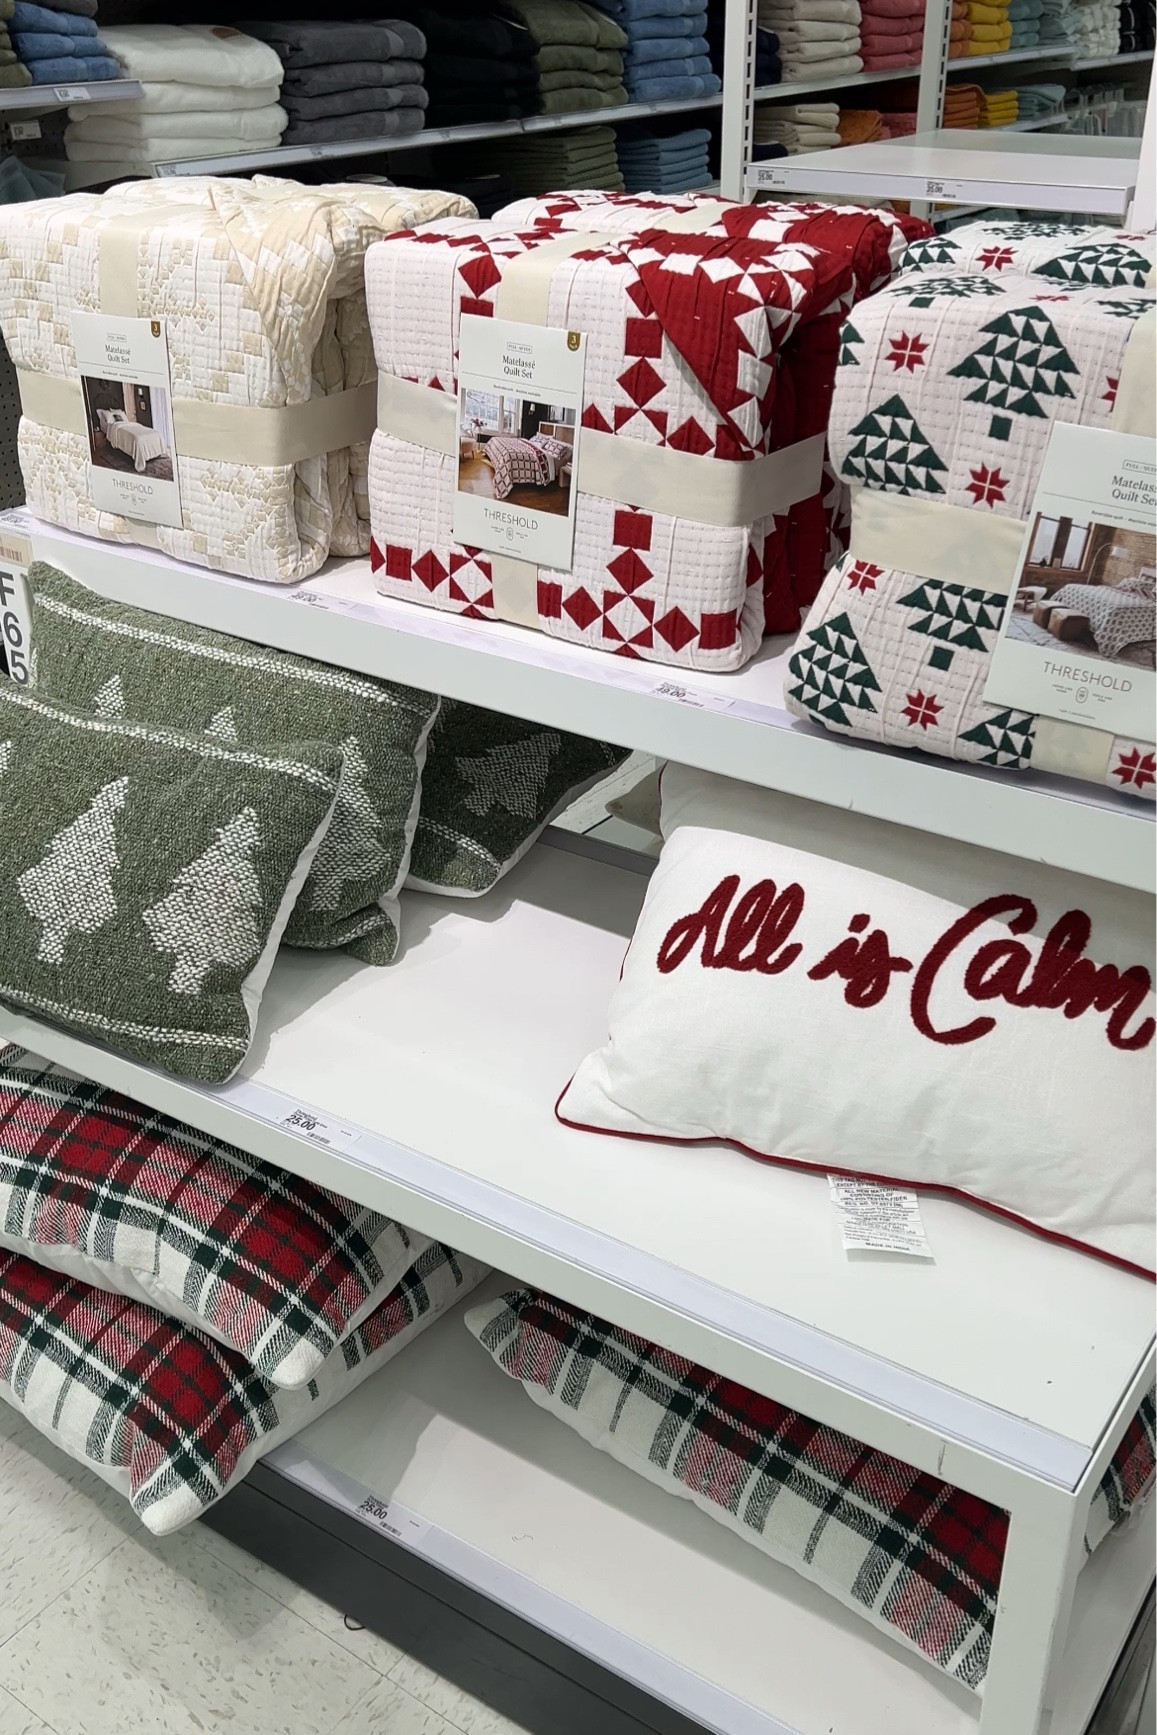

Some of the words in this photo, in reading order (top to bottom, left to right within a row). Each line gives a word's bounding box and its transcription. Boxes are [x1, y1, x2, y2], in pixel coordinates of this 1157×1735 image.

[571, 335, 577, 344] 3
[105, 344, 131, 356] Matelassé
[107, 354, 120, 363] Quilt
[121, 356, 130, 364] Set
[502, 355, 536, 369] Matelassé
[503, 366, 520, 377] Quilt
[521, 369, 533, 379] Set
[112, 478, 154, 495] THRESHOLD
[1112, 488, 1139, 503] Quilt
[484, 508, 539, 530] THRESHOLD
[1043, 661, 1133, 692] THRESHOLD
[656, 874, 806, 975] All
[807, 913, 914, 1009] is
[910, 894, 1156, 1051] Calm
[285, 1114, 316, 1131] 25.00
[360, 1500, 388, 1520] 25.00
